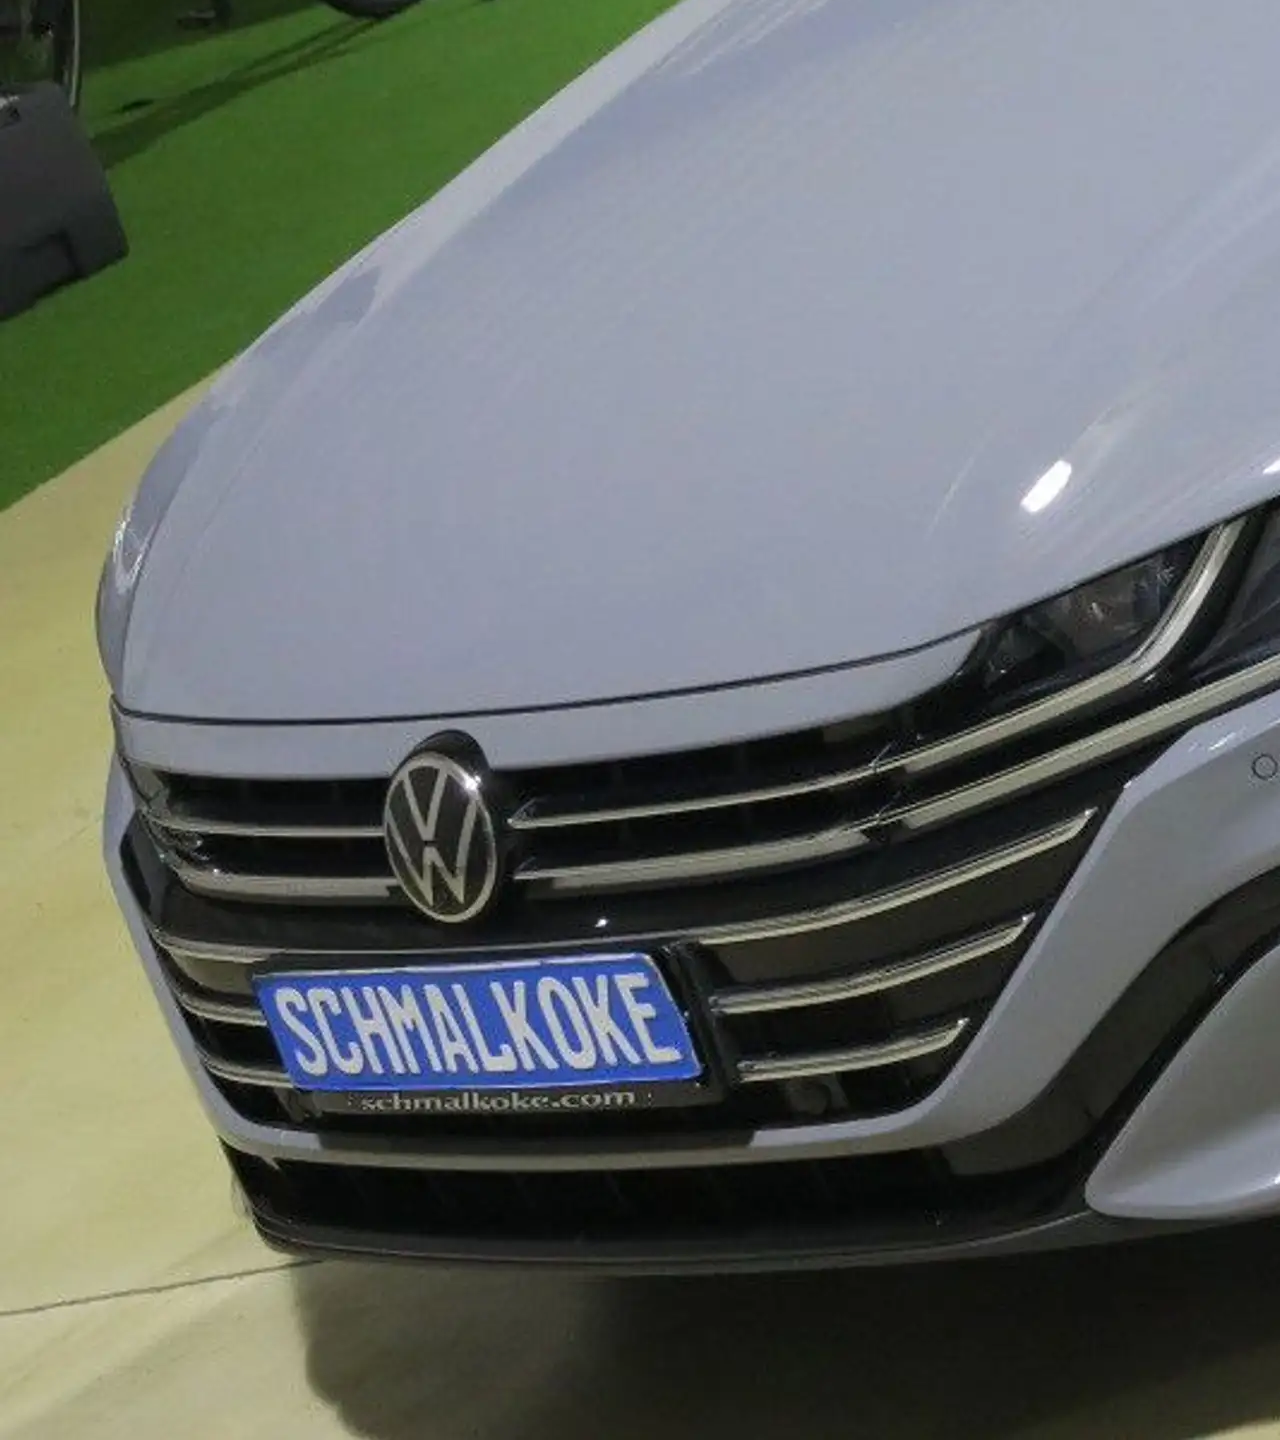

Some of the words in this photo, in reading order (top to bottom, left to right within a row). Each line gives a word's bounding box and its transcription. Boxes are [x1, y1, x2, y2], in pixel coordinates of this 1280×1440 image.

[385, 755, 494, 919] VW
[274, 971, 682, 1076] SCHMALKOKE
[361, 1090, 636, 1113] schmalkoke.com
